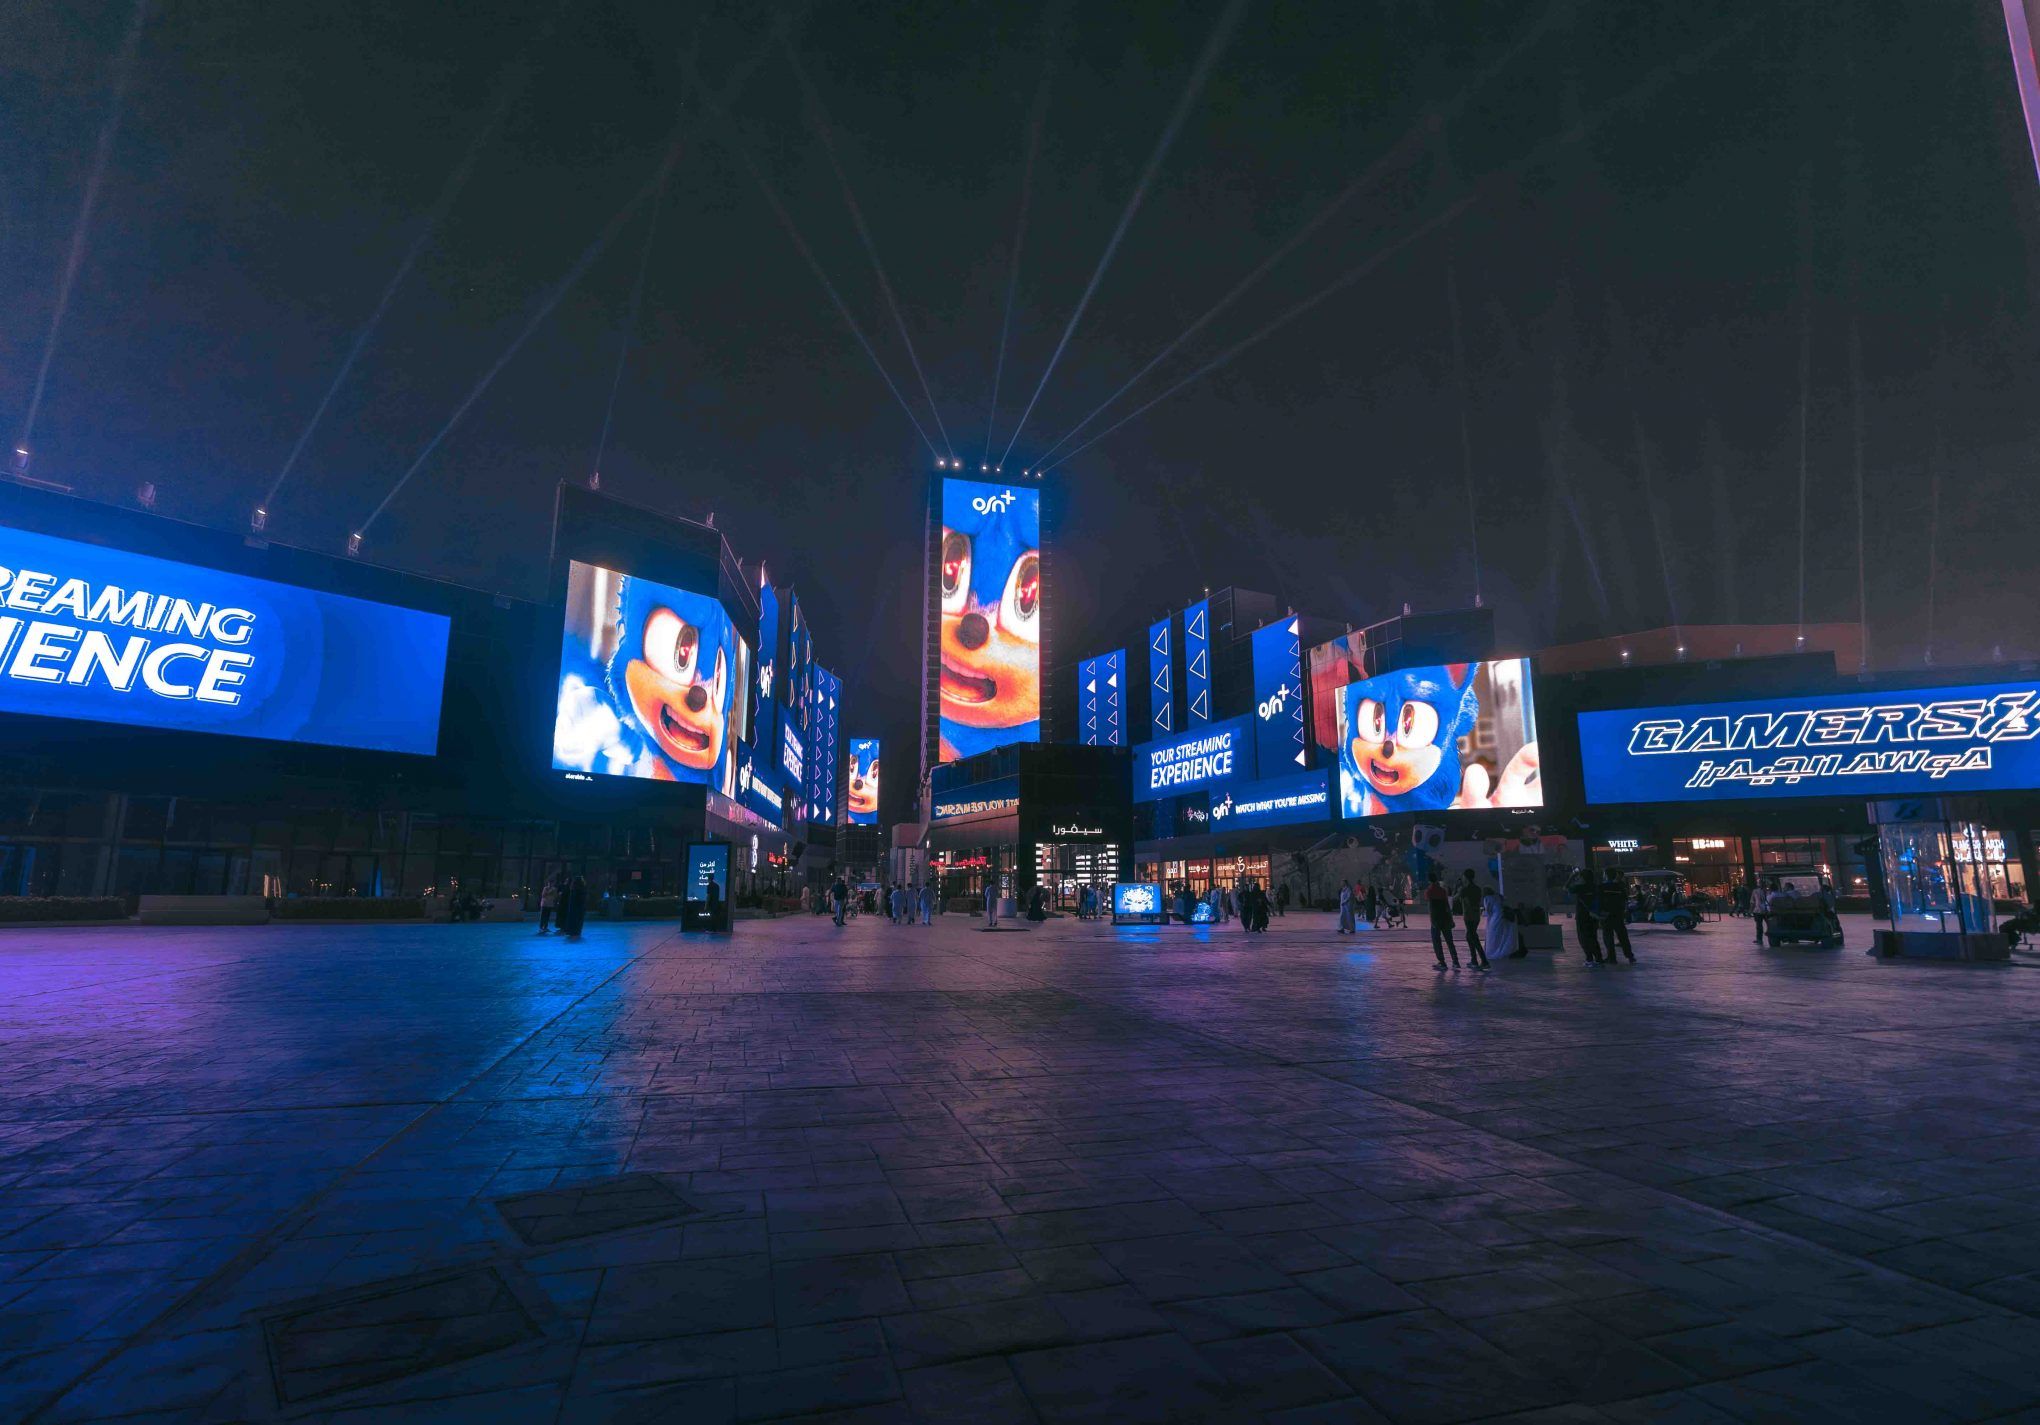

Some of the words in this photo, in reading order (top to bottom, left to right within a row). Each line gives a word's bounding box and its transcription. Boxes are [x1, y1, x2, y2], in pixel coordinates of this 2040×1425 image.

[0, 565, 256, 645] EAMING
[1151, 748, 1174, 766] YOUR
[1176, 733, 1231, 760] STREAMING
[1151, 750, 1232, 789] EXPERIENCE
[1235, 802, 1256, 814] WATCH
[1256, 800, 1274, 812] WHAT
[1274, 796, 1298, 809] YOU'RE
[1298, 792, 1327, 806] MISSING
[1608, 839, 1639, 848] WHITE
